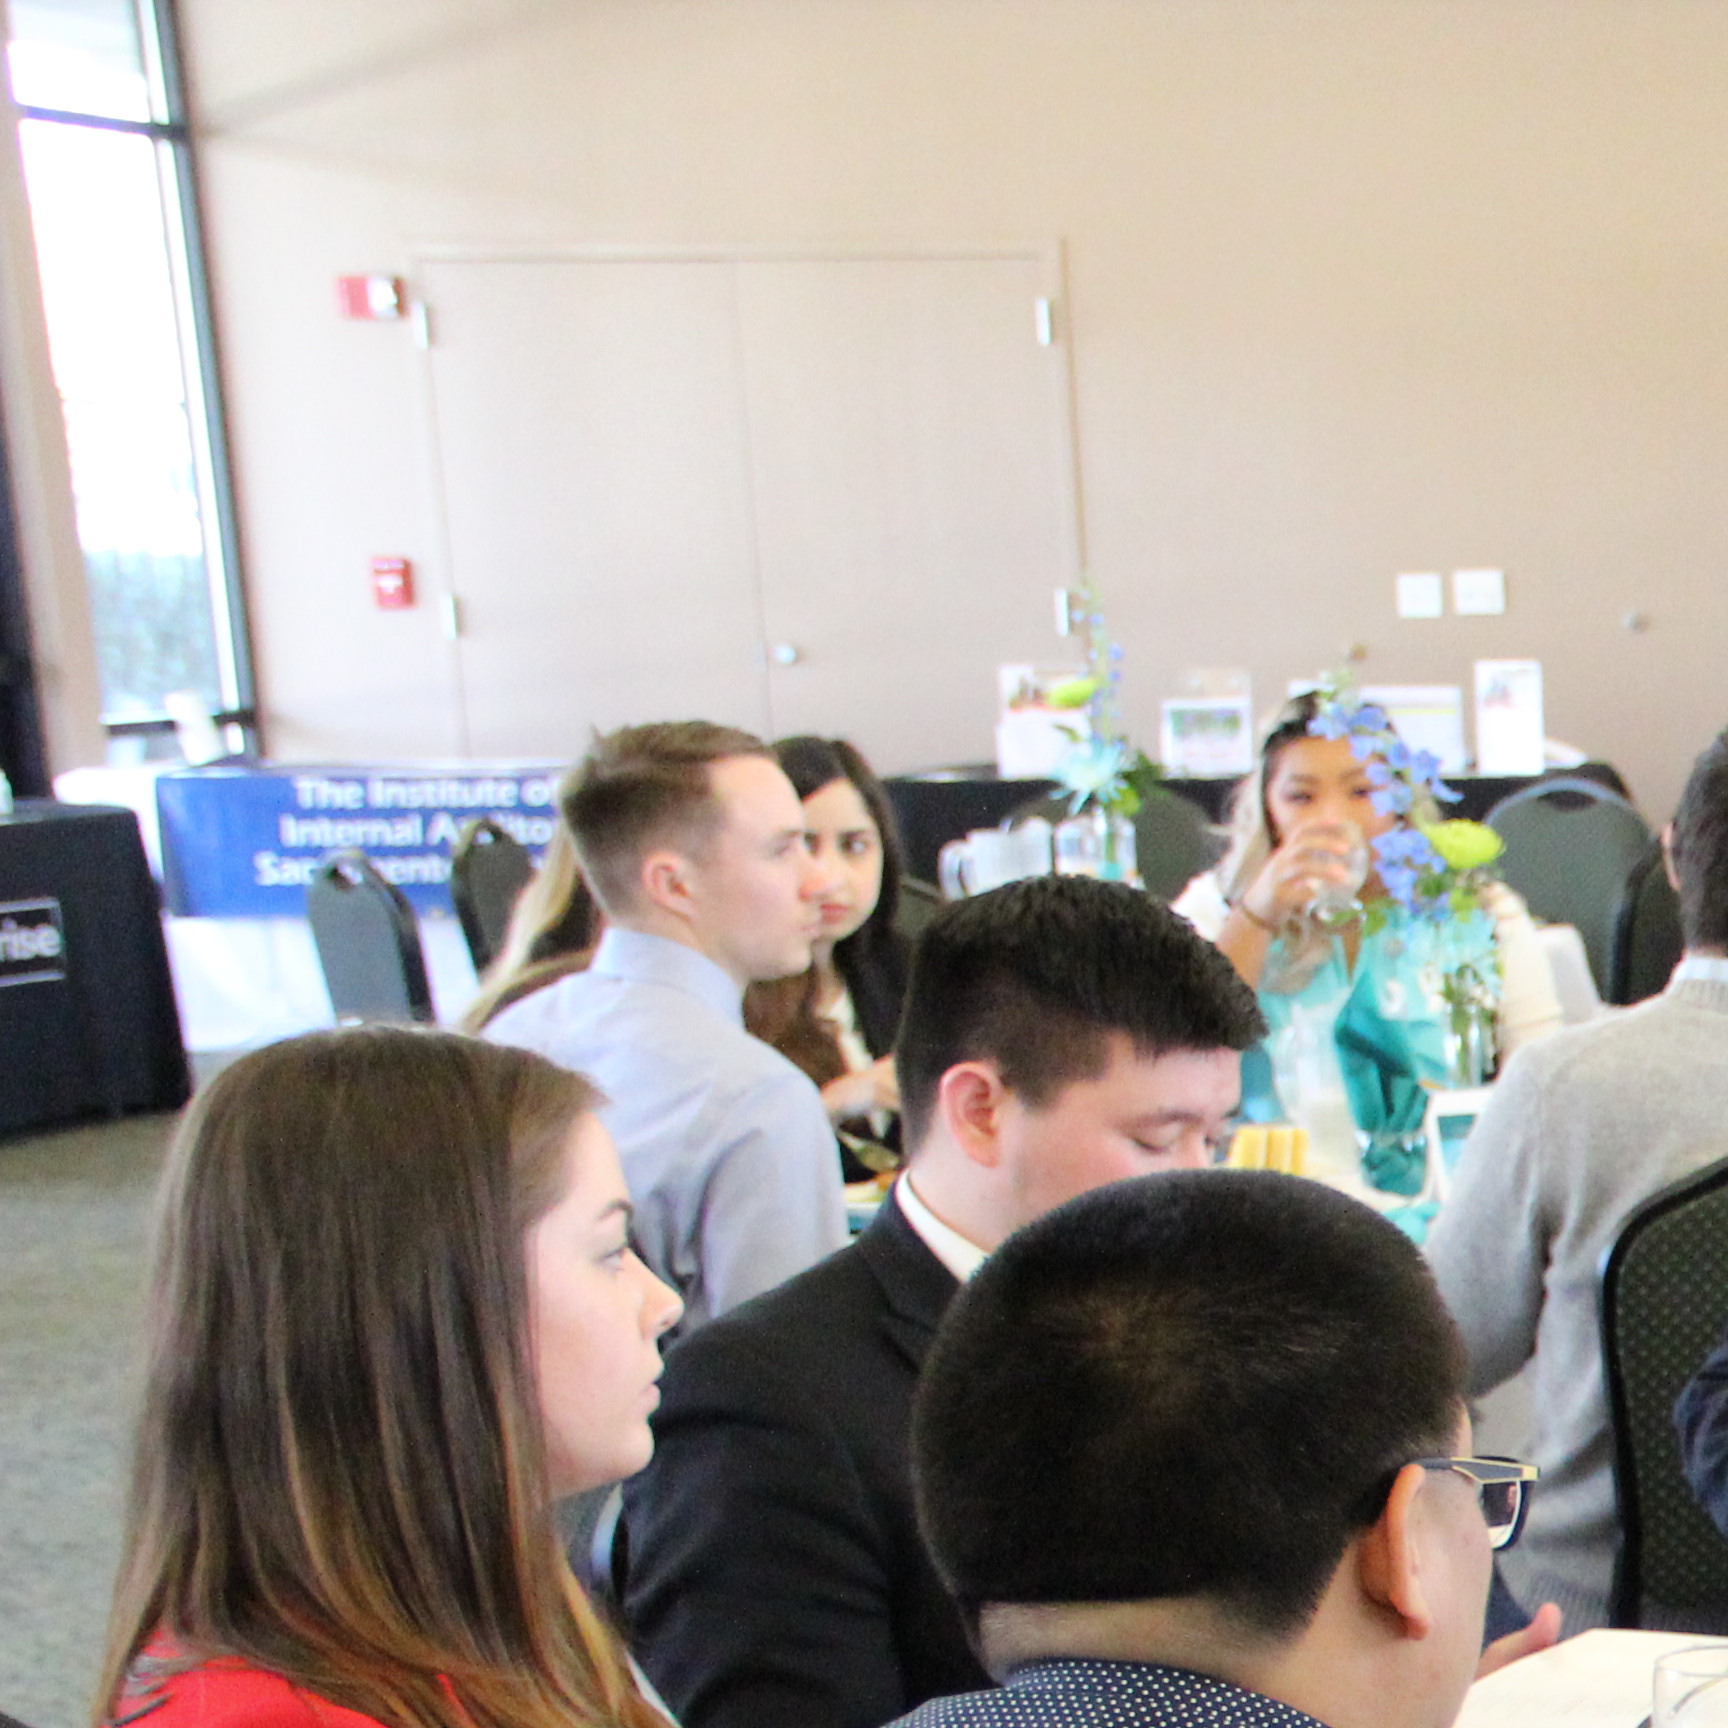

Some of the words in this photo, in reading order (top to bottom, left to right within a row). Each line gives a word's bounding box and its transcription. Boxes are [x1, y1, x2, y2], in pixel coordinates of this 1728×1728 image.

[295, 778, 365, 808] The
[367, 778, 519, 807] Institute
[279, 812, 424, 848] Internal
